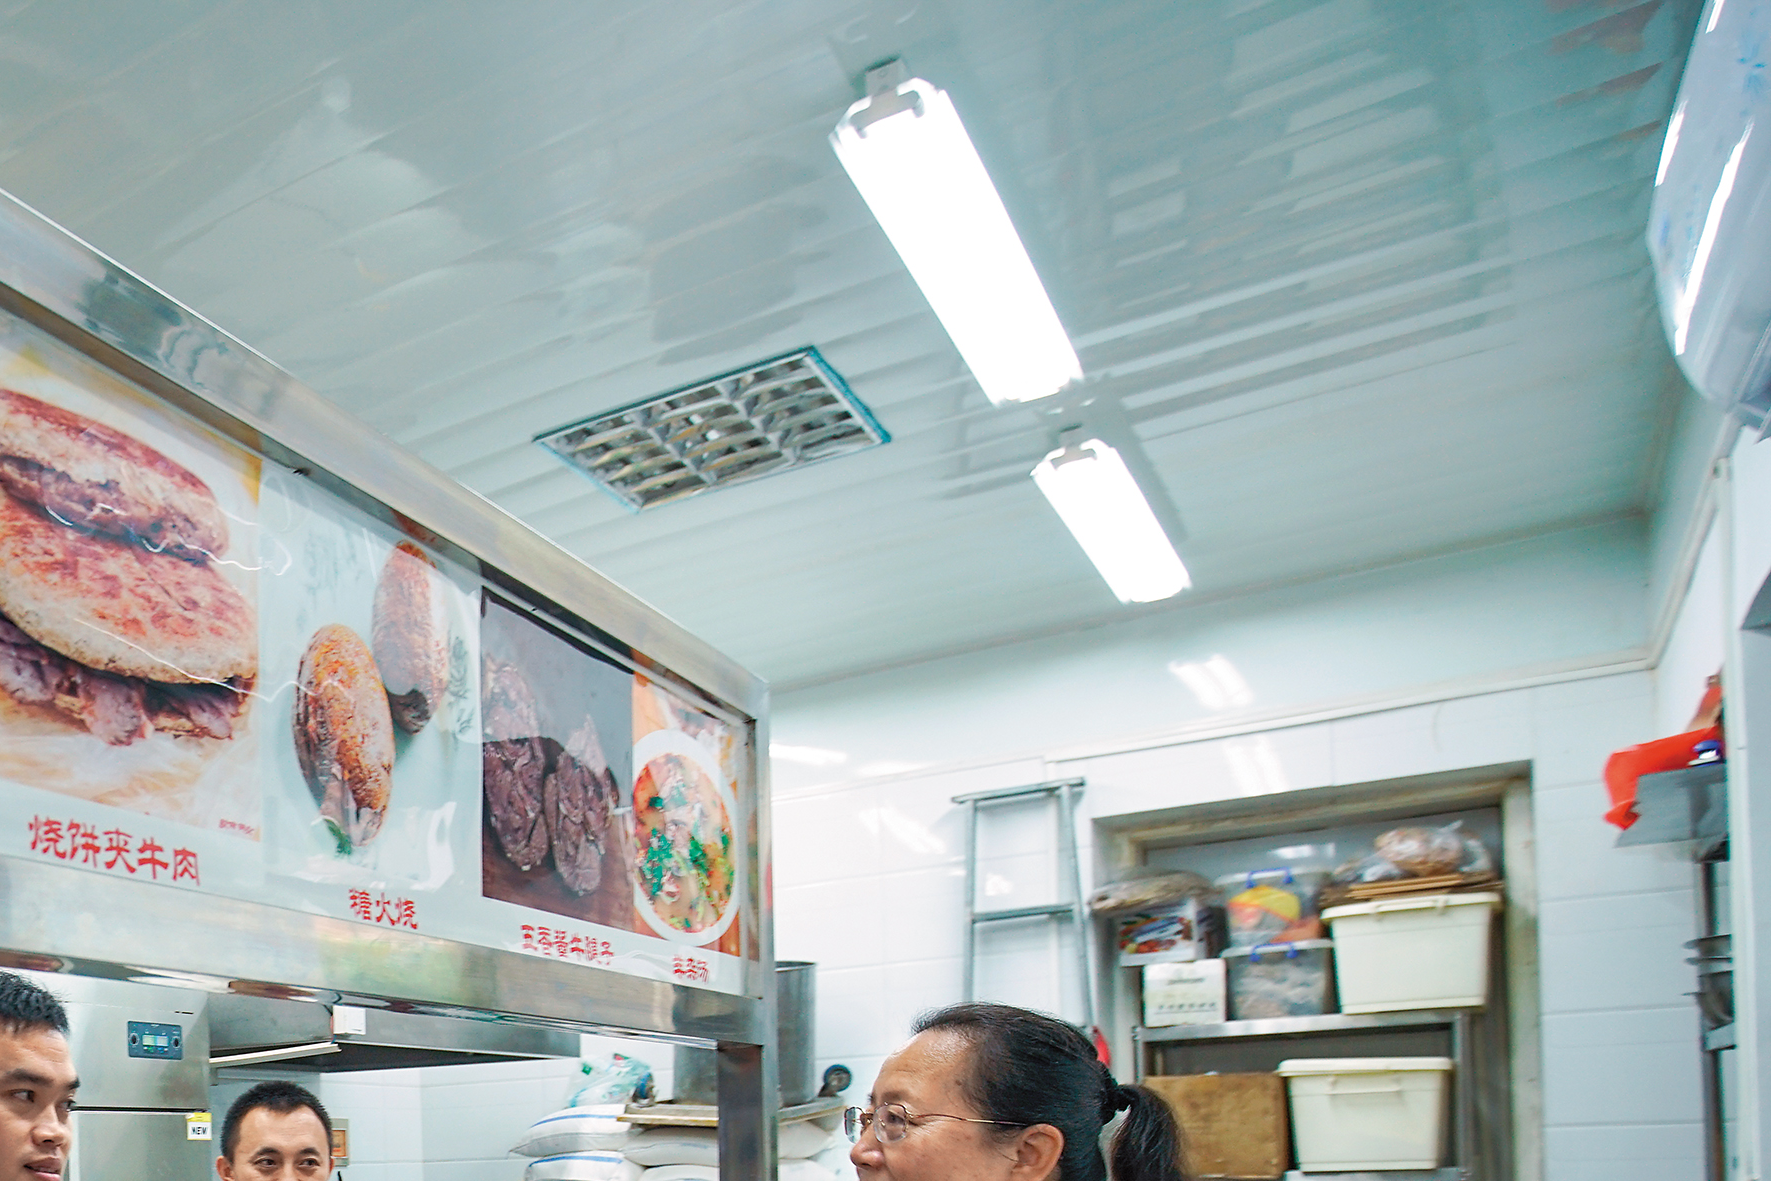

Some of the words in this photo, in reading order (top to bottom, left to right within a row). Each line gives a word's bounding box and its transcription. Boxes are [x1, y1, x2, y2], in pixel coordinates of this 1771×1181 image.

[28, 815, 200, 886] 烧饼夹牛肉
